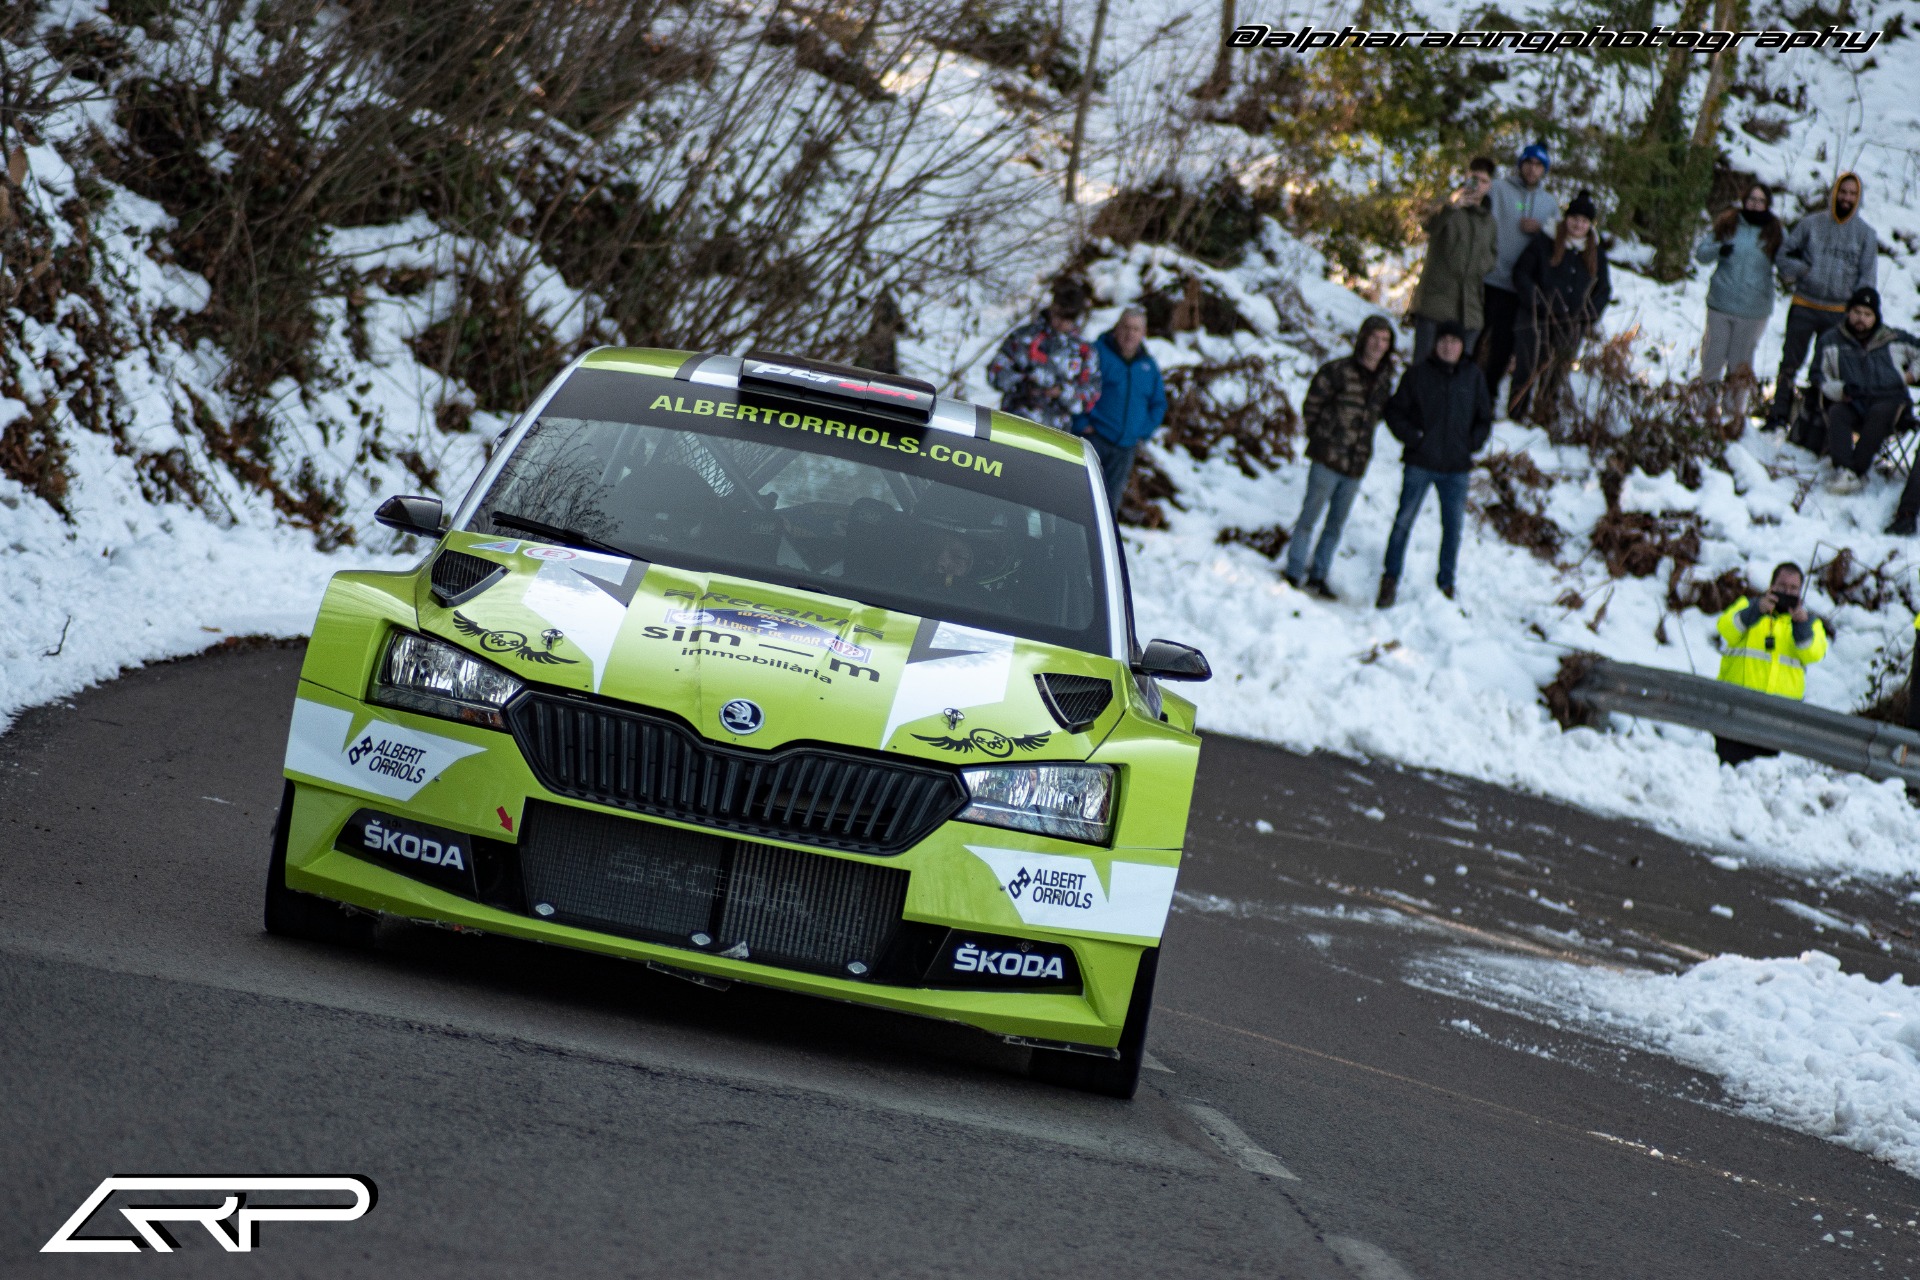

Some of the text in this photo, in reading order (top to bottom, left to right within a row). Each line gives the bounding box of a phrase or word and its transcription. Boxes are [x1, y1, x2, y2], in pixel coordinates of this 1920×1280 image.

[649, 395, 1003, 477] ALBERTORRIOLS.COM
[641, 625, 742, 647] sim
[715, 618, 763, 633] LLORET
[790, 634, 821, 646] MAR
[758, 620, 778, 631] 2
[681, 647, 832, 684] immobiliària
[373, 739, 426, 765] ALBERT
[369, 756, 426, 783] ORRIOLS
[363, 820, 464, 870] ŠKODA
[1033, 868, 1087, 890] ALBERT
[1033, 886, 1093, 909] ORRIOLS
[954, 943, 1063, 979] ŠKODA
